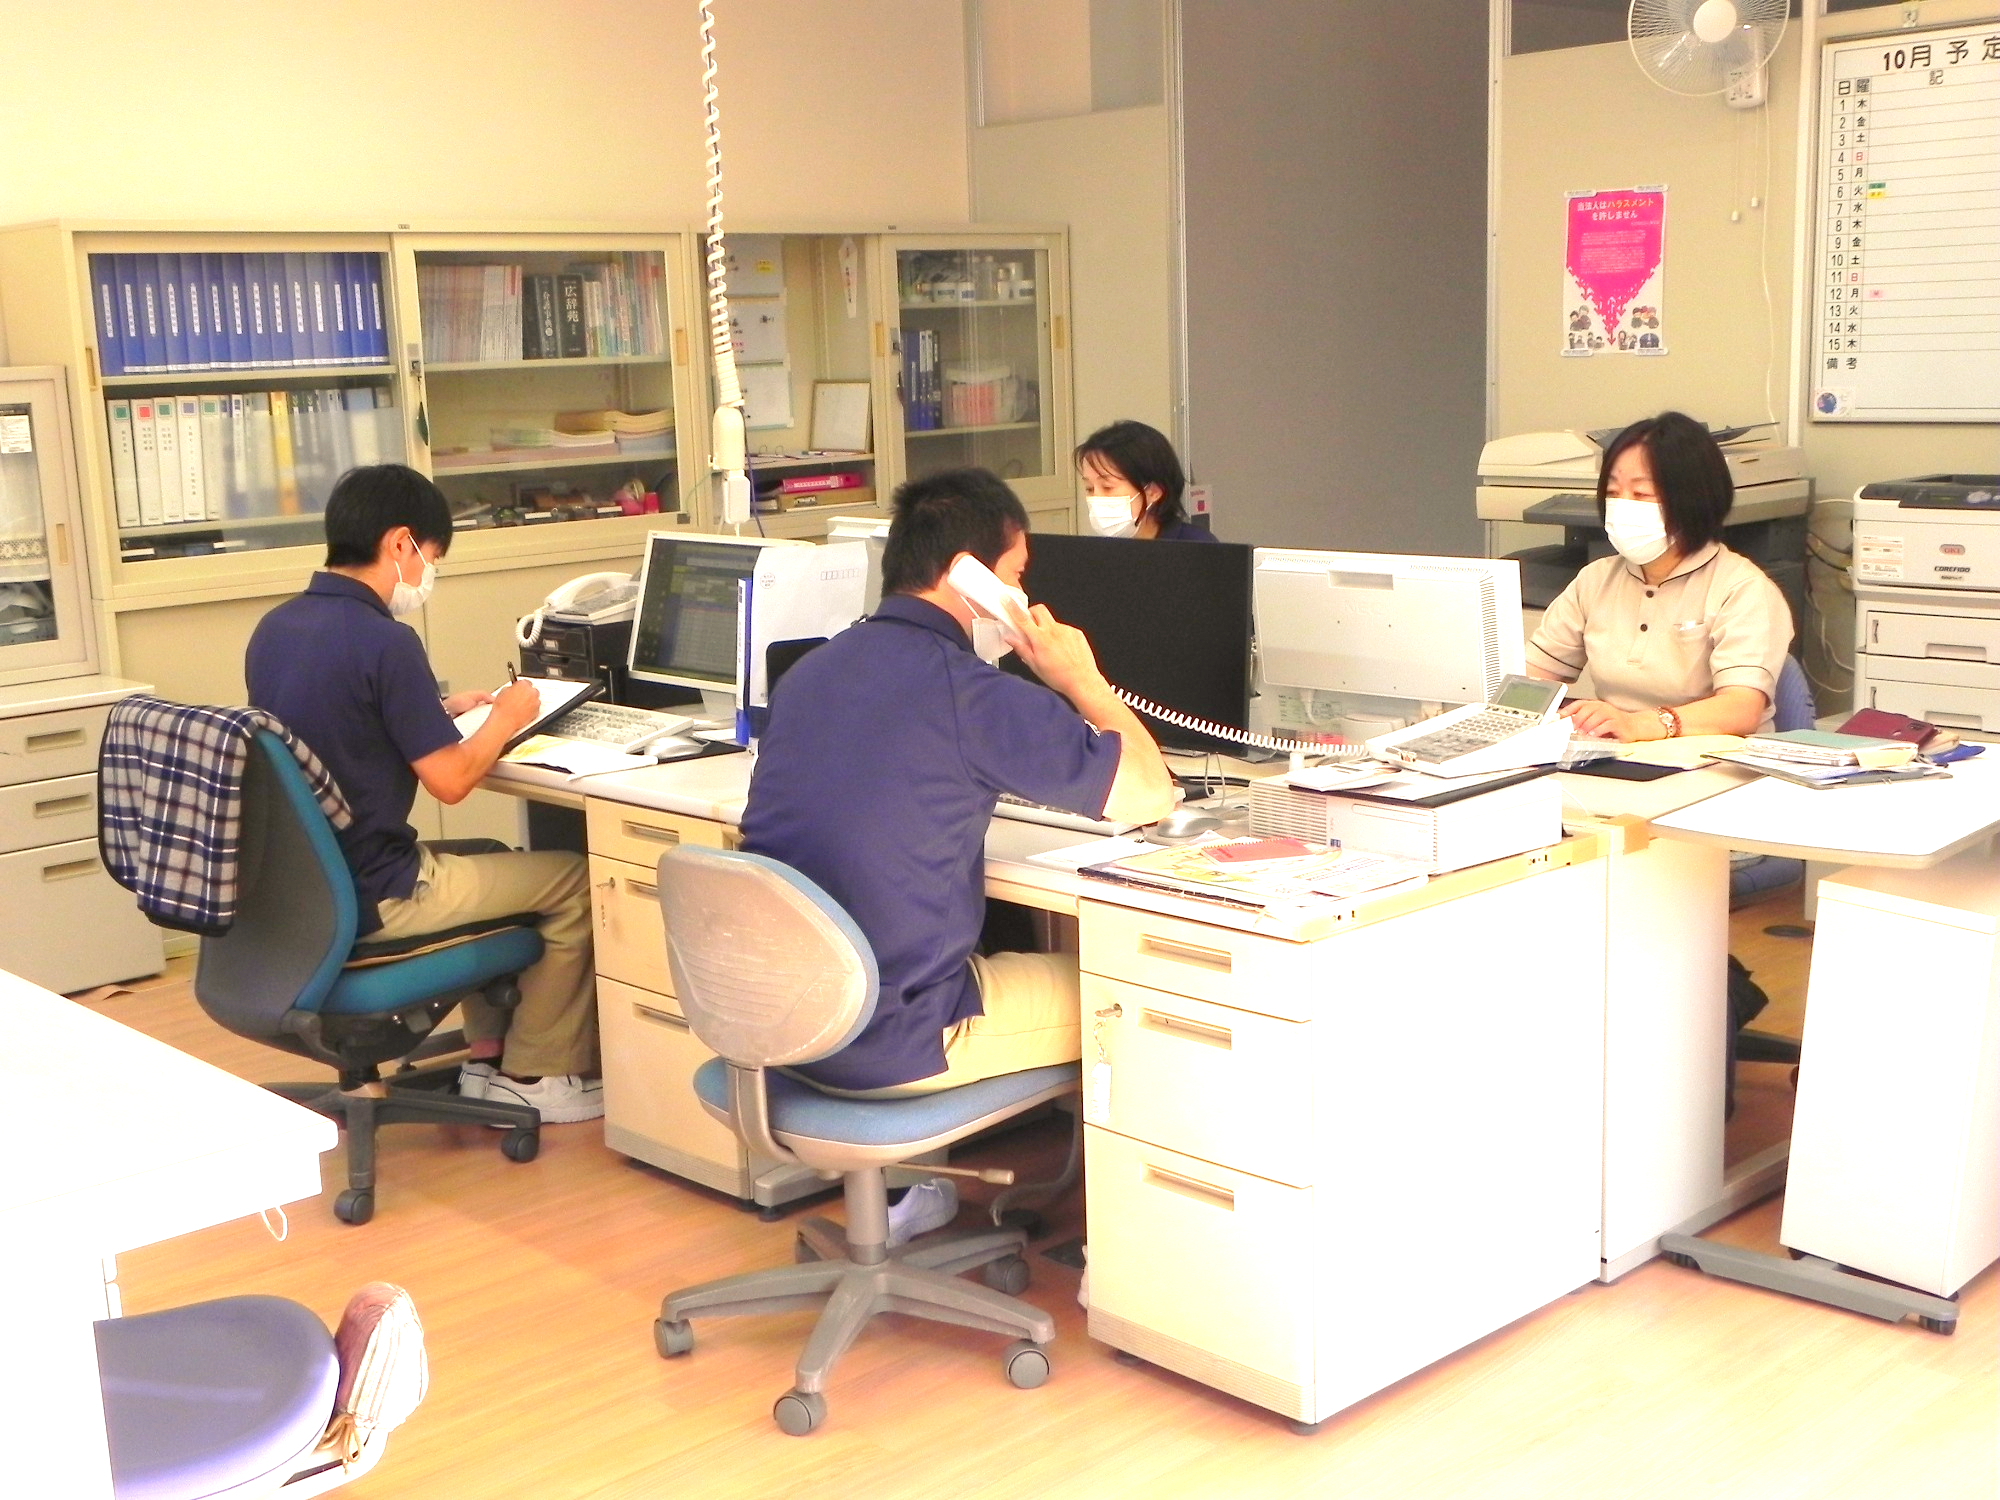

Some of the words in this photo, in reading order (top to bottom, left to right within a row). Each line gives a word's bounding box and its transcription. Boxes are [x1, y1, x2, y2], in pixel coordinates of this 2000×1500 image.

[1838, 80, 1851, 96] 日
[1856, 78, 1870, 94] 曜
[1929, 69, 1944, 86] 記
[1840, 99, 1845, 111] 1
[1857, 98, 1867, 109] 木
[1839, 117, 1846, 129] 2
[1856, 116, 1867, 127] 金
[1839, 134, 1845, 147] 3
[1856, 133, 1866, 143] 土
[1838, 152, 1844, 164] 4
[1856, 152, 1863, 161] 日
[1837, 168, 1844, 181] 5
[1855, 167, 1863, 178] 月
[1837, 186, 1843, 198] 6
[1854, 185, 1864, 196] 火
[1836, 204, 1843, 215] 7
[1853, 202, 1863, 213] 水
[1592, 210, 1638, 221] を許しません
[1835, 219, 1842, 232] 8
[1852, 219, 1862, 229] 木
[1835, 236, 1841, 249] 9
[1852, 236, 1862, 247] 金
[1831, 254, 1843, 266] 10
[1851, 255, 1860, 265] 土
[1831, 271, 1842, 283] 11
[1851, 272, 1859, 282] 日
[1830, 288, 1842, 300] 12
[1850, 288, 1859, 298] 月
[564, 285, 579, 322] 広辞苑
[1829, 305, 1841, 317] 13
[1849, 305, 1858, 316] 火
[1828, 322, 1841, 333] 14
[1847, 323, 1857, 333] 水
[1828, 338, 1840, 350] 15
[1847, 339, 1857, 349] 木
